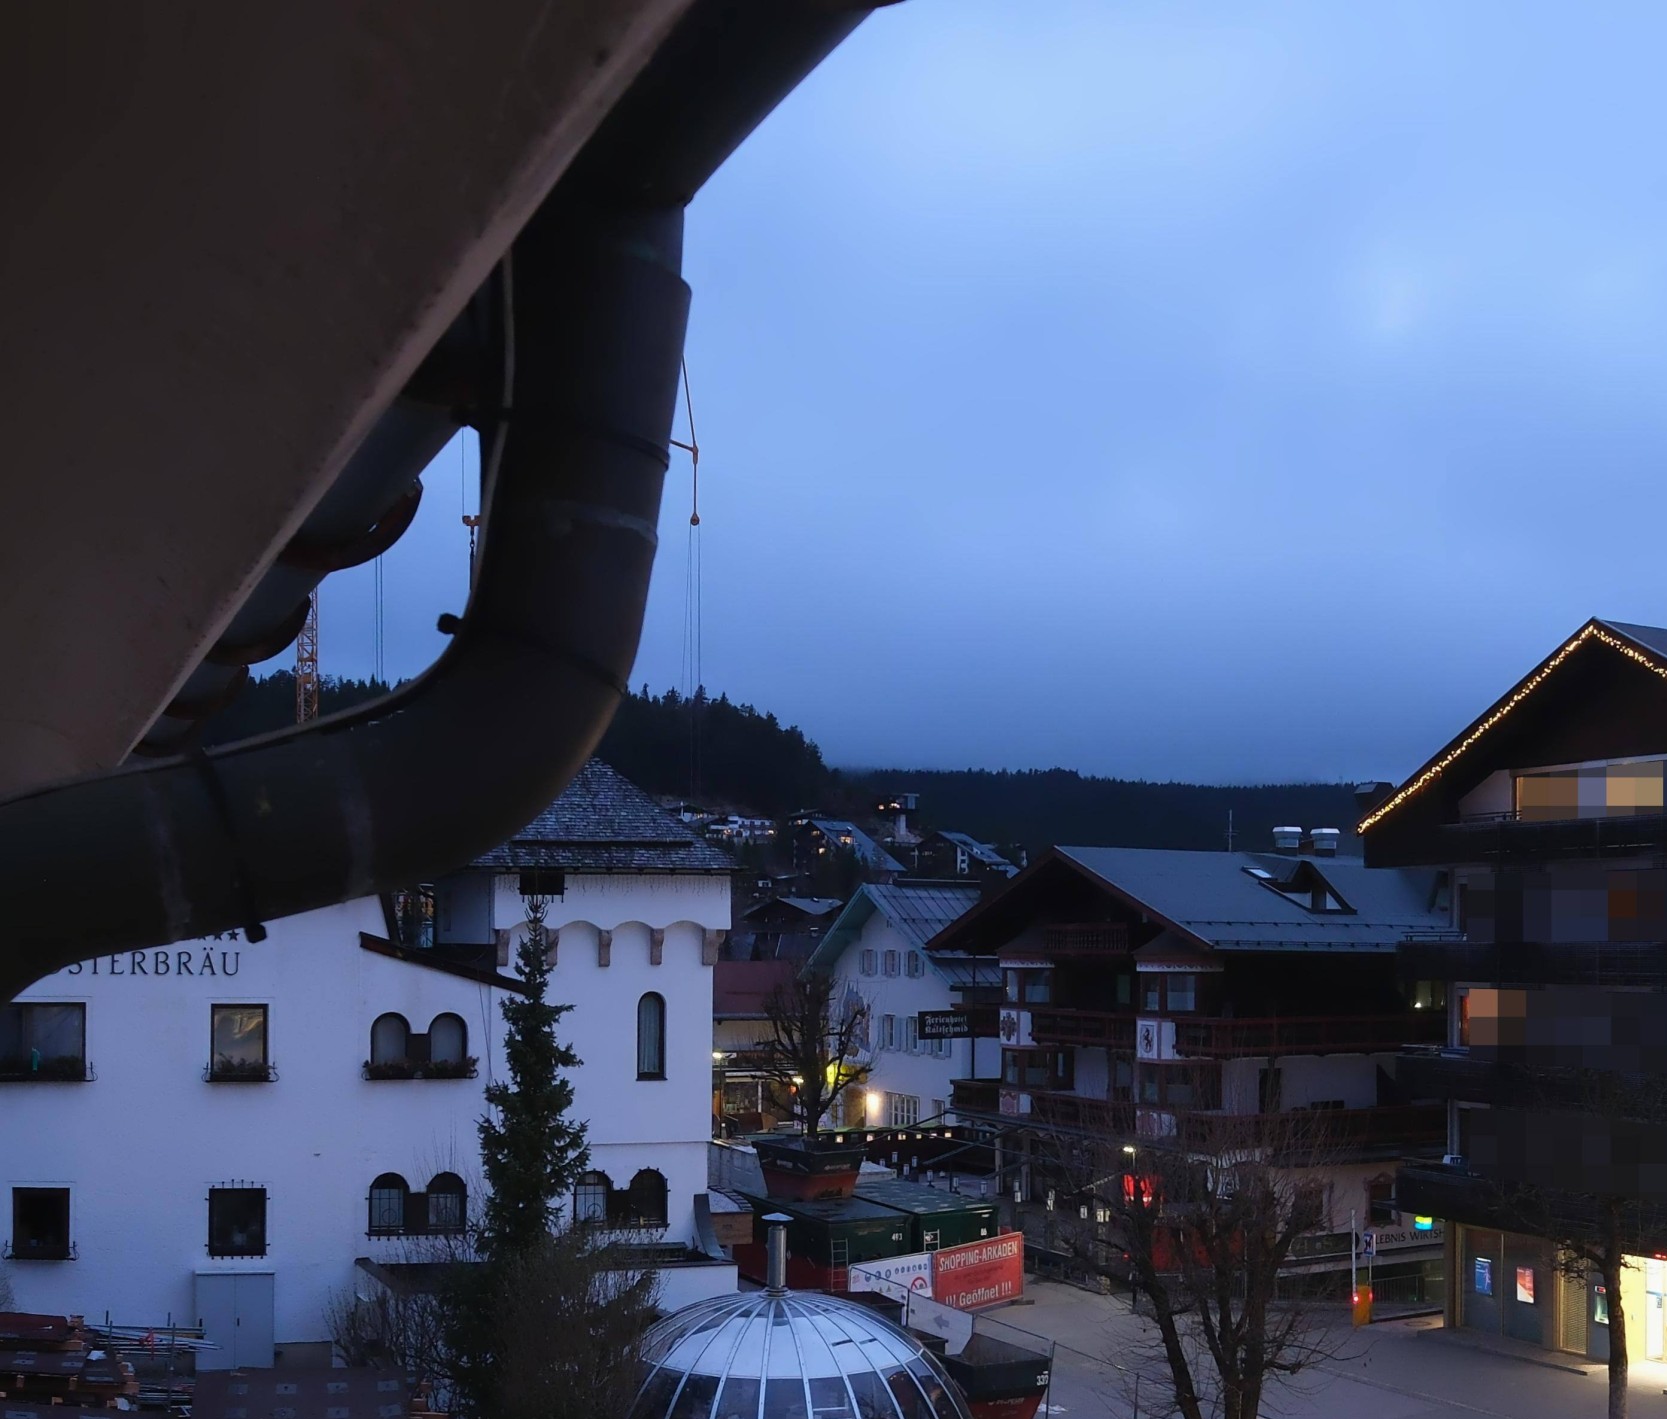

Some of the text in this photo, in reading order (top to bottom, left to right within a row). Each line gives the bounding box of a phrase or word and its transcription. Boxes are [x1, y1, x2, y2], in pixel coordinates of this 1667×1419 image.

[47, 947, 241, 976] STERBRÄU
[938, 1240, 1018, 1272] SHOPPING-ARKADEN
[959, 1284, 999, 1307] Geöffnet
